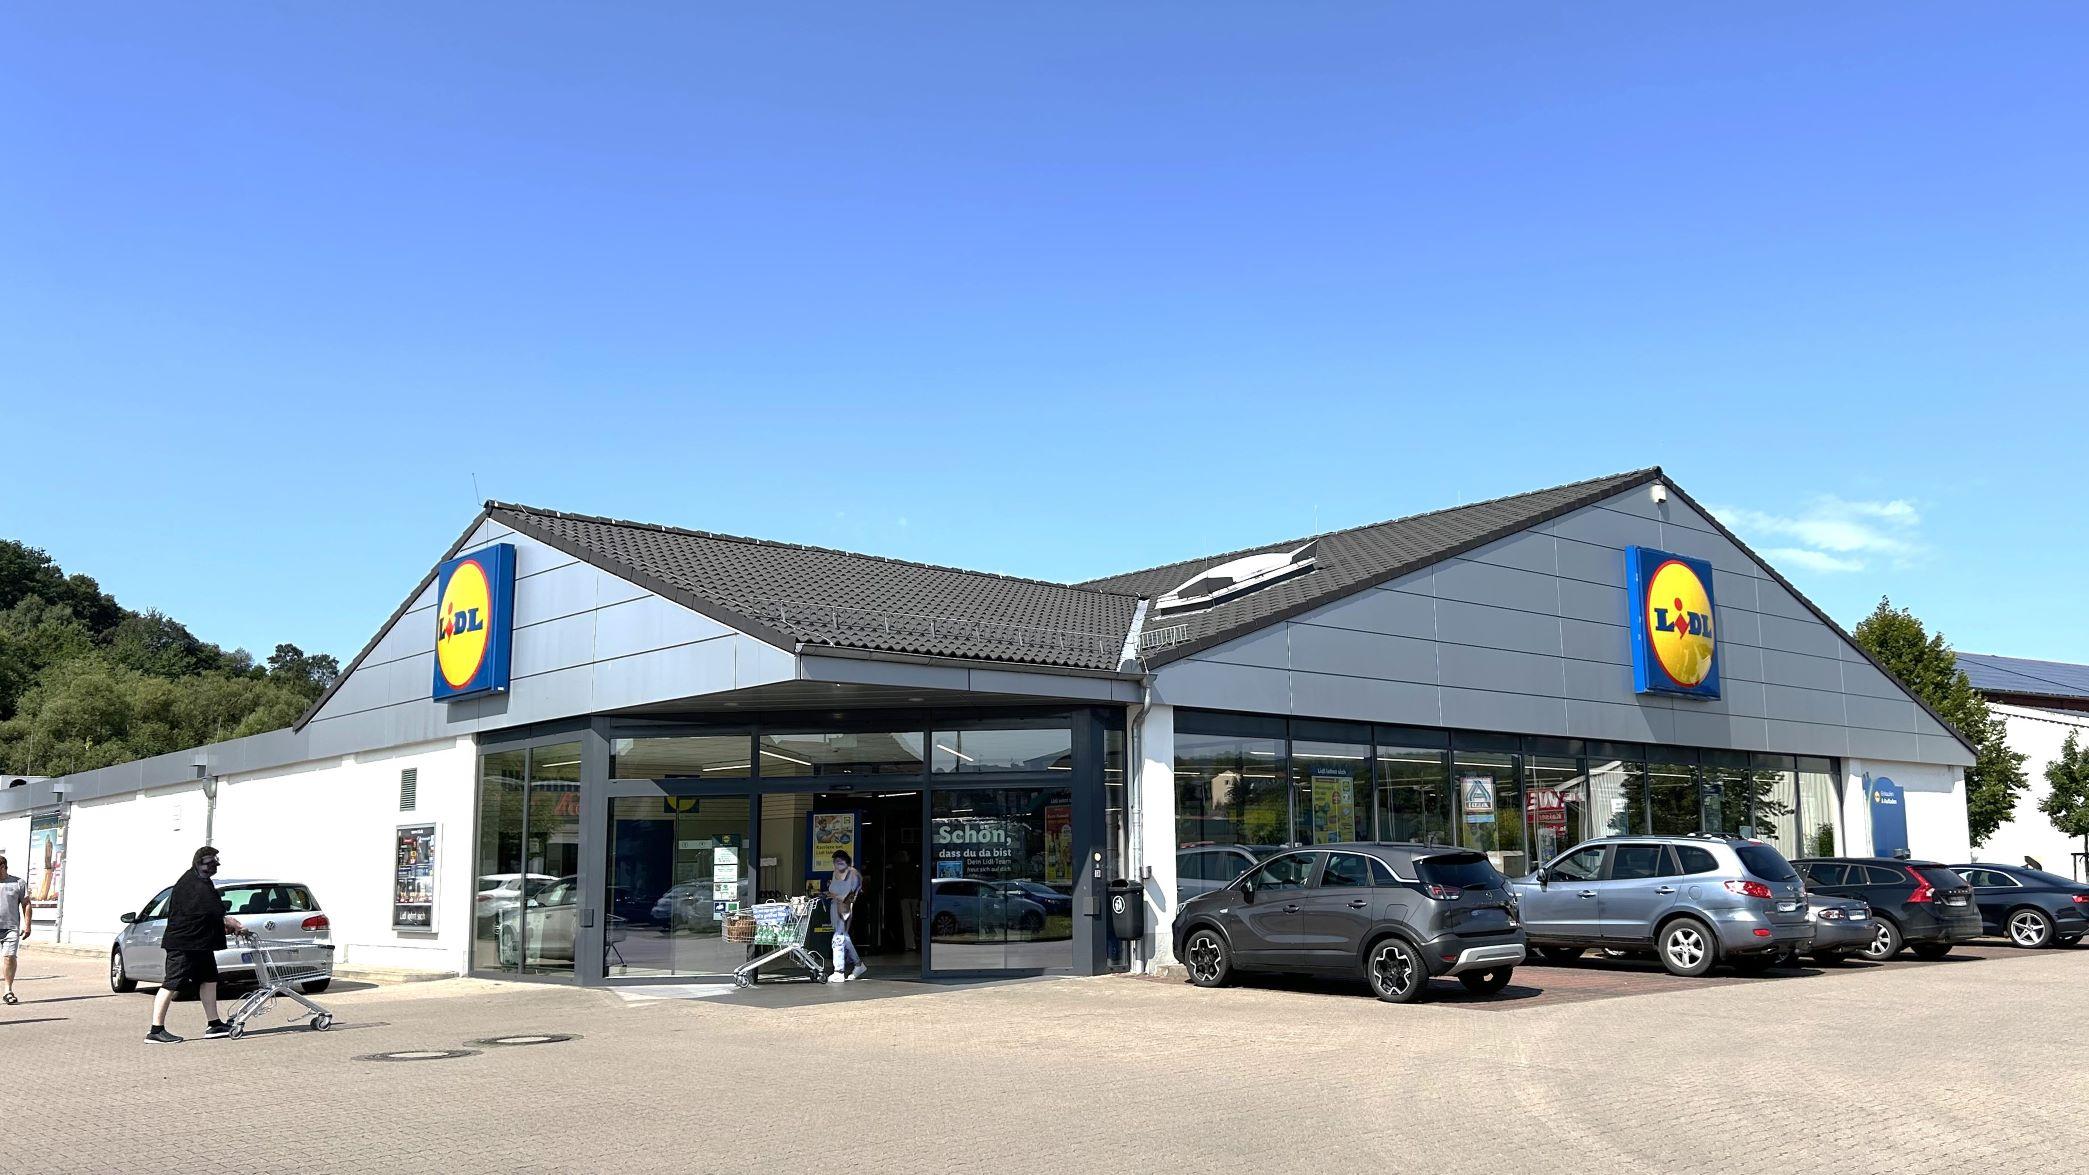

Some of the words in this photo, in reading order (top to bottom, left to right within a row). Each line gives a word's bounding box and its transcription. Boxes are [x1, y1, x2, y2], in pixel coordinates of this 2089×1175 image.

[939, 824, 1012, 846] Schön,
[939, 849, 961, 858] dass
[963, 849, 977, 857] du
[979, 849, 991, 857] da
[993, 848, 1012, 857] bist
